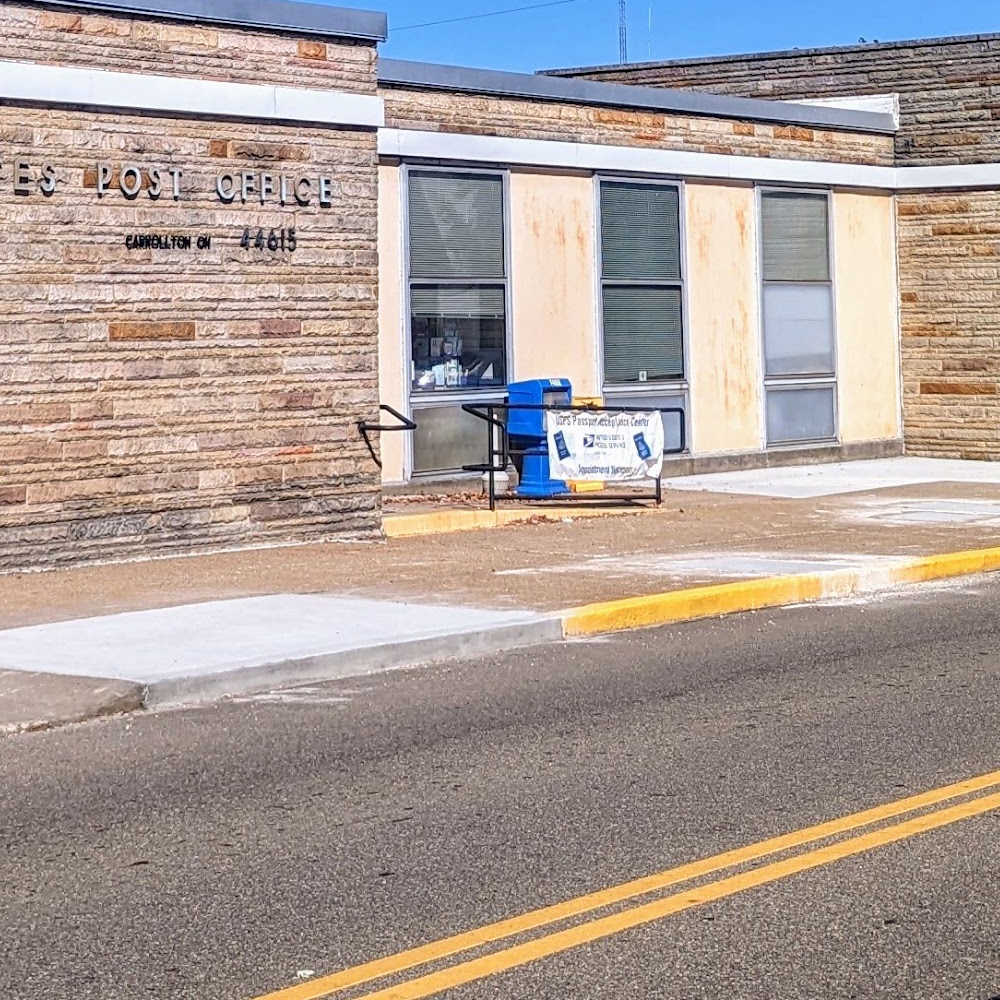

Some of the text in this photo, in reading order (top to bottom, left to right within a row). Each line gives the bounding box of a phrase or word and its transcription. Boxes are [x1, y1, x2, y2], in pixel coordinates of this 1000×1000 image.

[97, 163, 182, 199] POST
[216, 171, 332, 206] OFFICE
[125, 235, 191, 250] CARROLLTON
[240, 227, 297, 252] 44615
